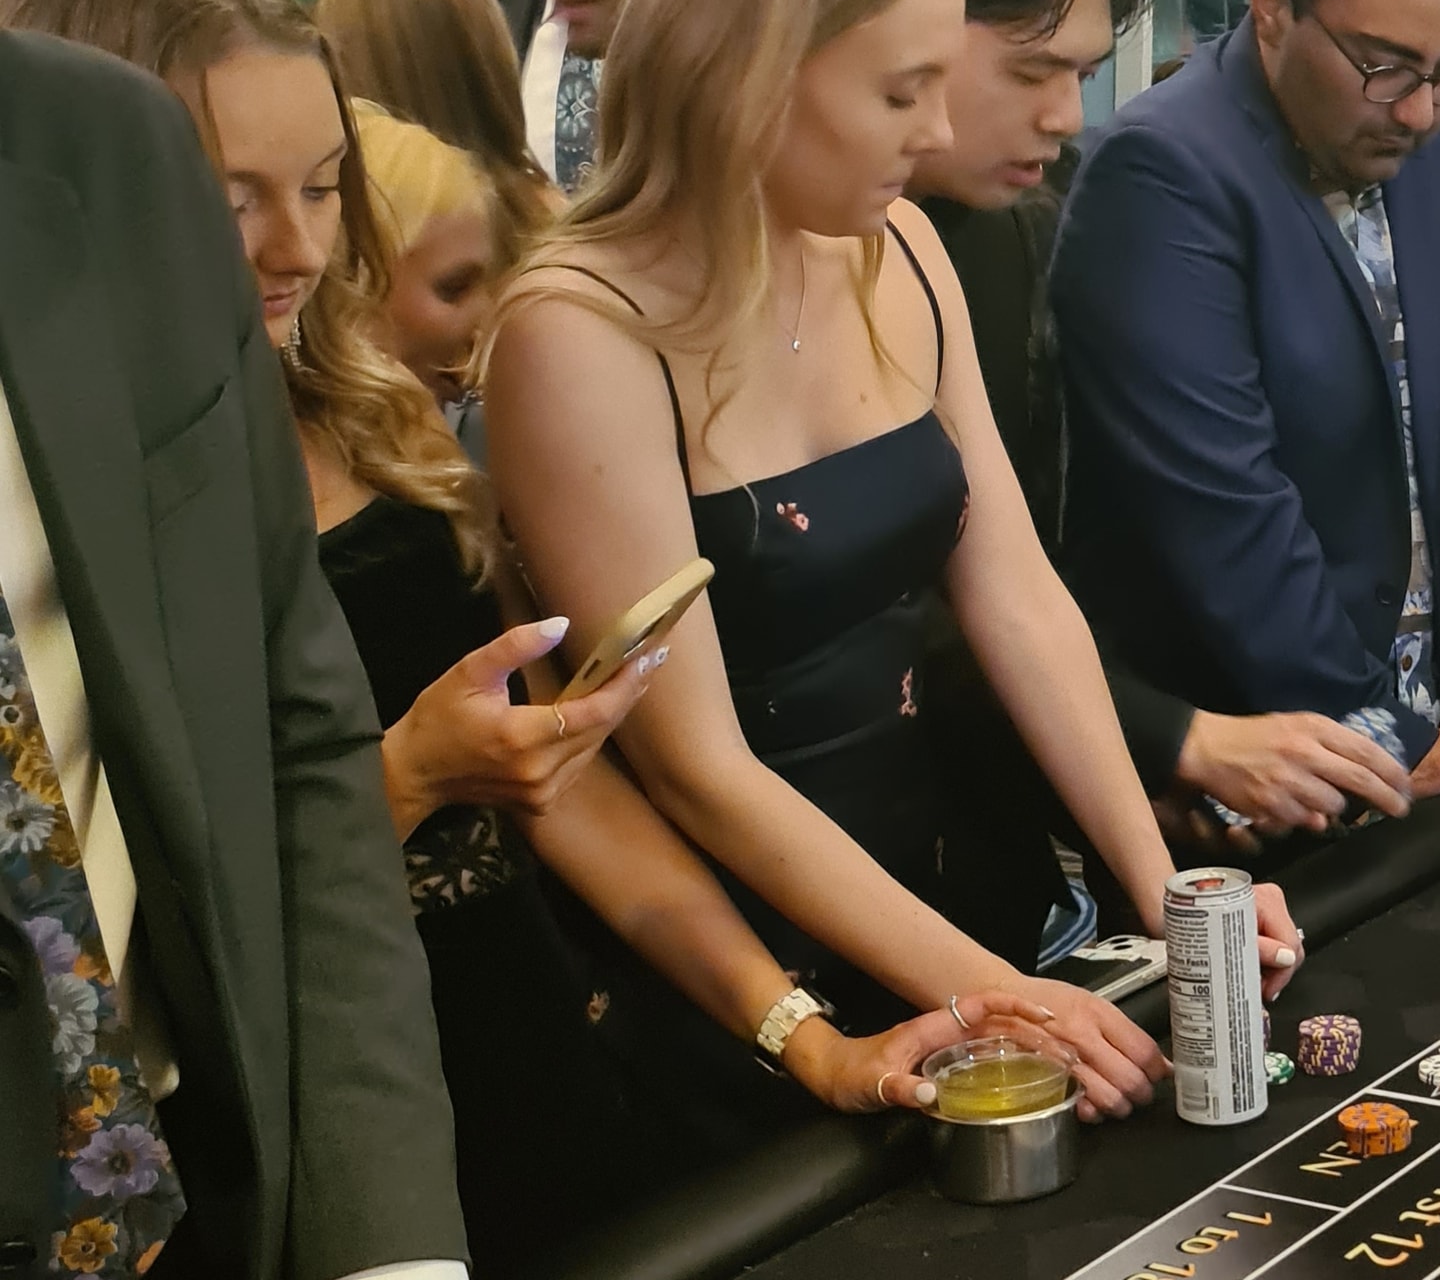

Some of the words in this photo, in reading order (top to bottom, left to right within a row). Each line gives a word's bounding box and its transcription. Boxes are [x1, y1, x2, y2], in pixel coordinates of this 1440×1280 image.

[1192, 984, 1210, 995] 100
[1223, 1210, 1274, 1228] 1
[1177, 1225, 1240, 1256] to
[1343, 1231, 1426, 1269] 12
